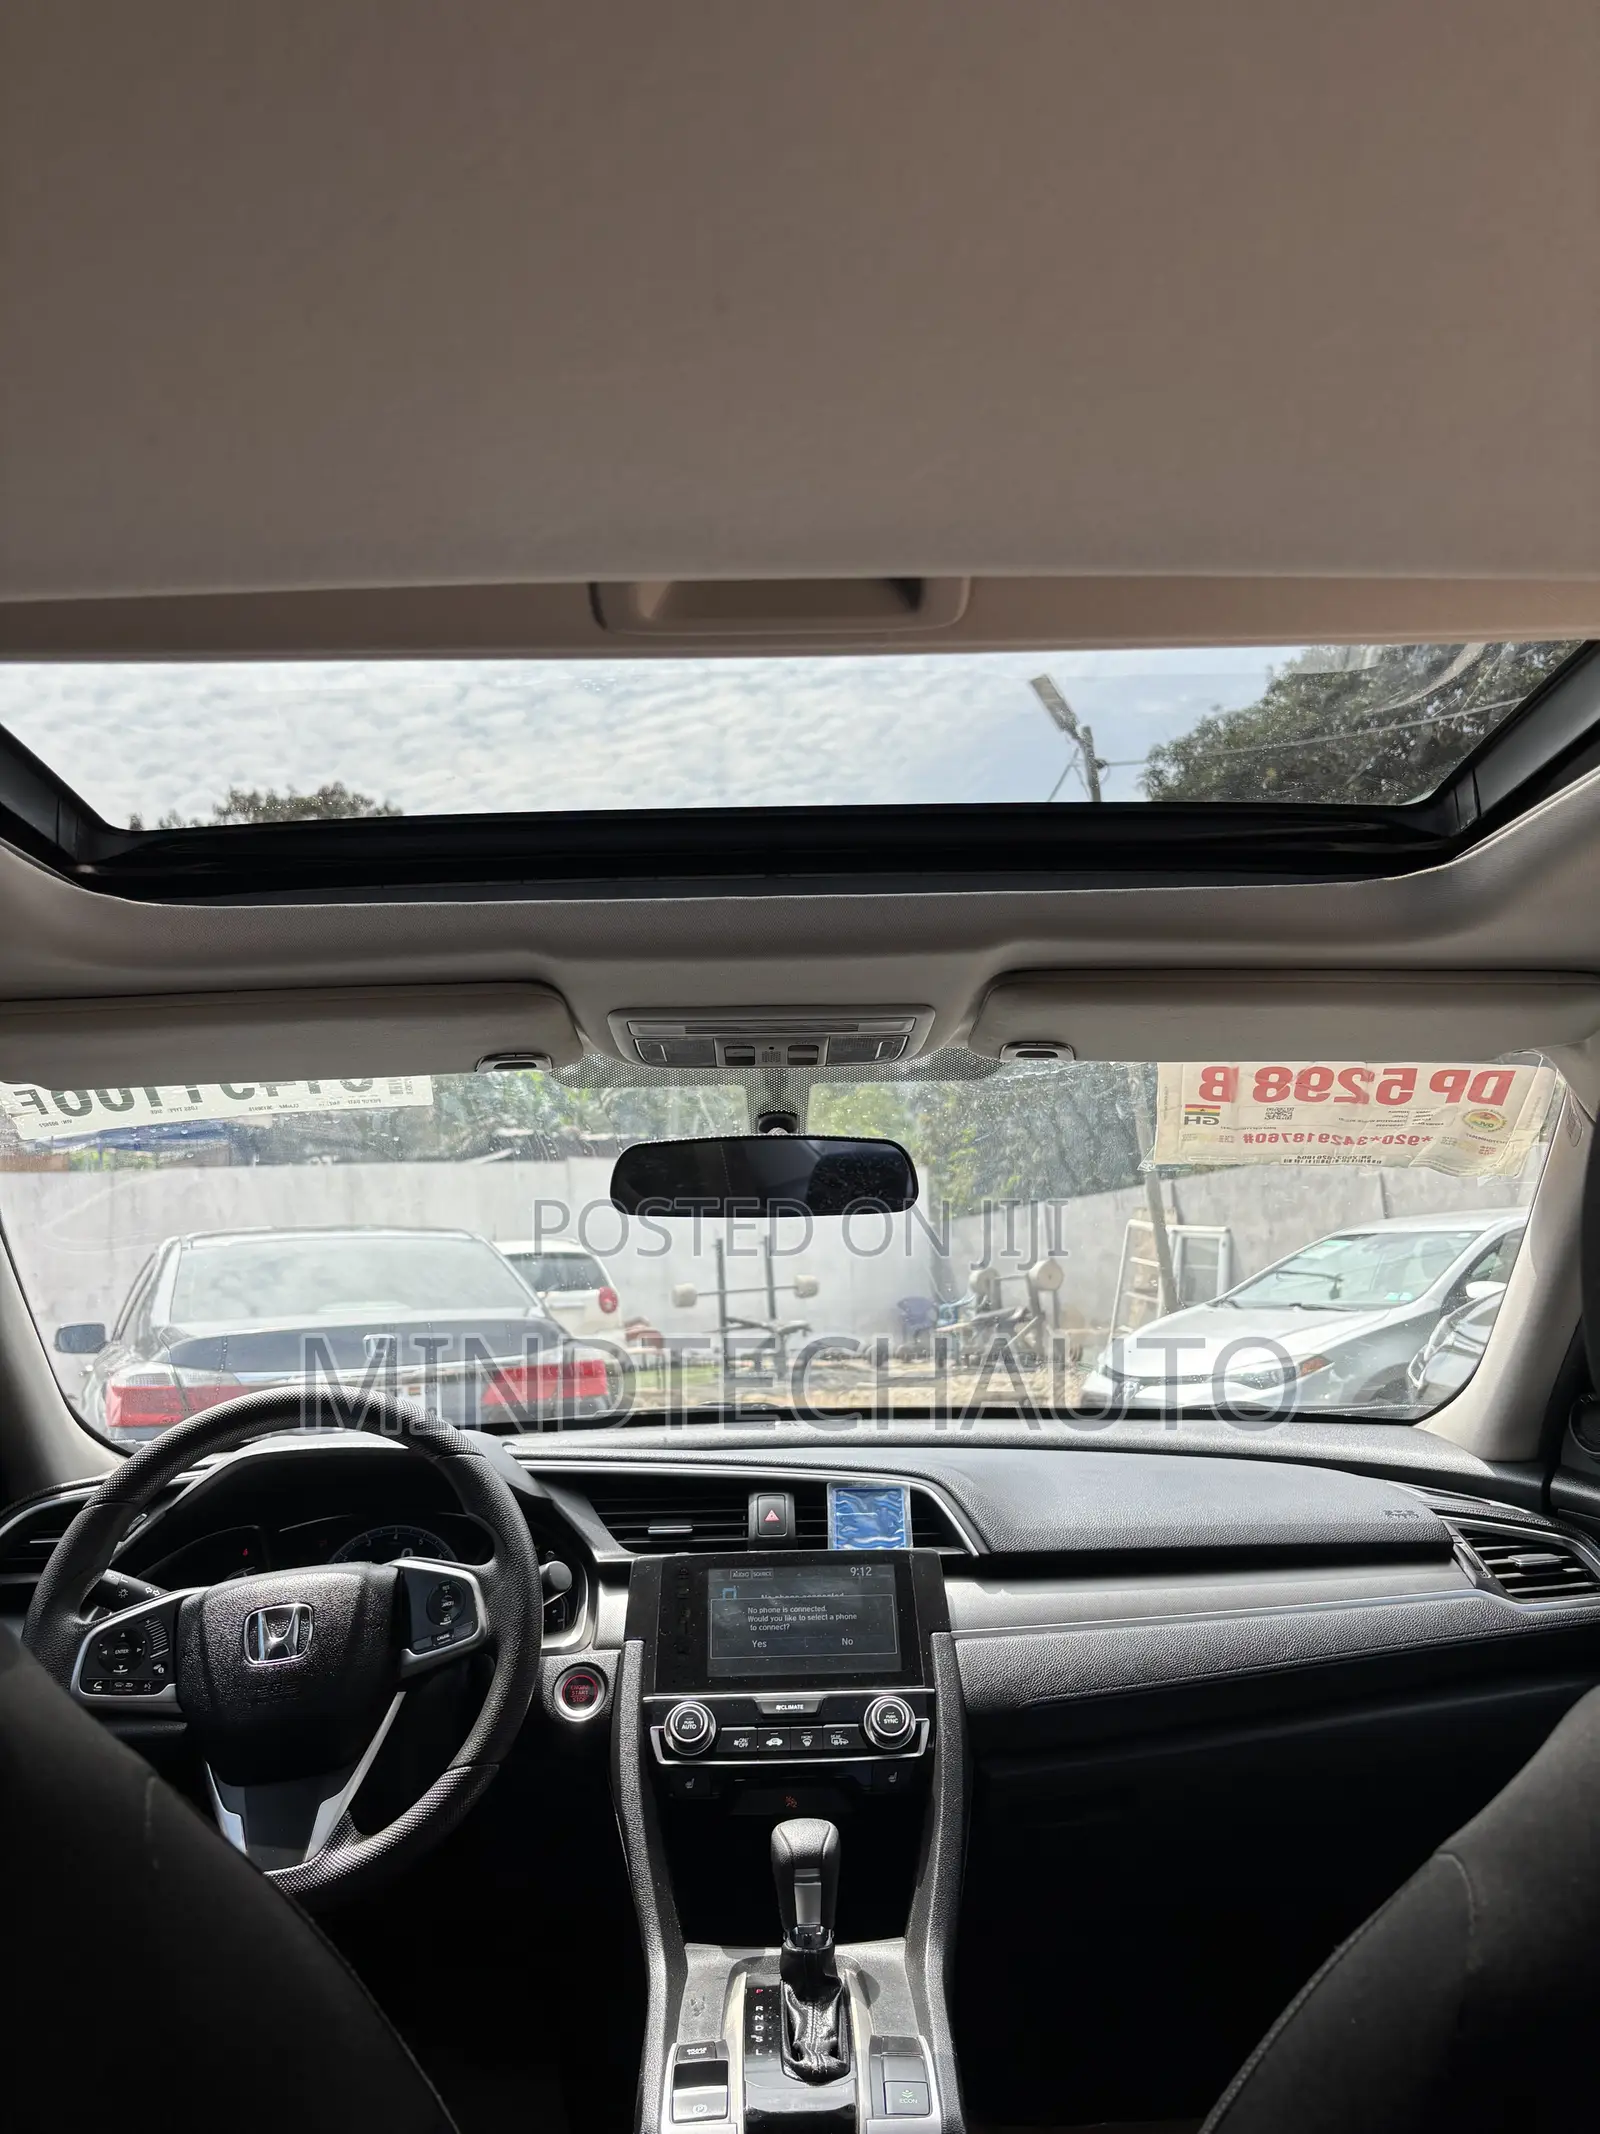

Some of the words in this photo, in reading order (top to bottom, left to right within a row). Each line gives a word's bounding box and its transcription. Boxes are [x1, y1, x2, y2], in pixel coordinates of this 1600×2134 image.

[850, 1567, 872, 1576] 9:12
[760, 1607, 780, 1615] phone
[836, 1613, 857, 1621] phone
[752, 1640, 767, 1648] Yes
[842, 1637, 853, 1645] No
